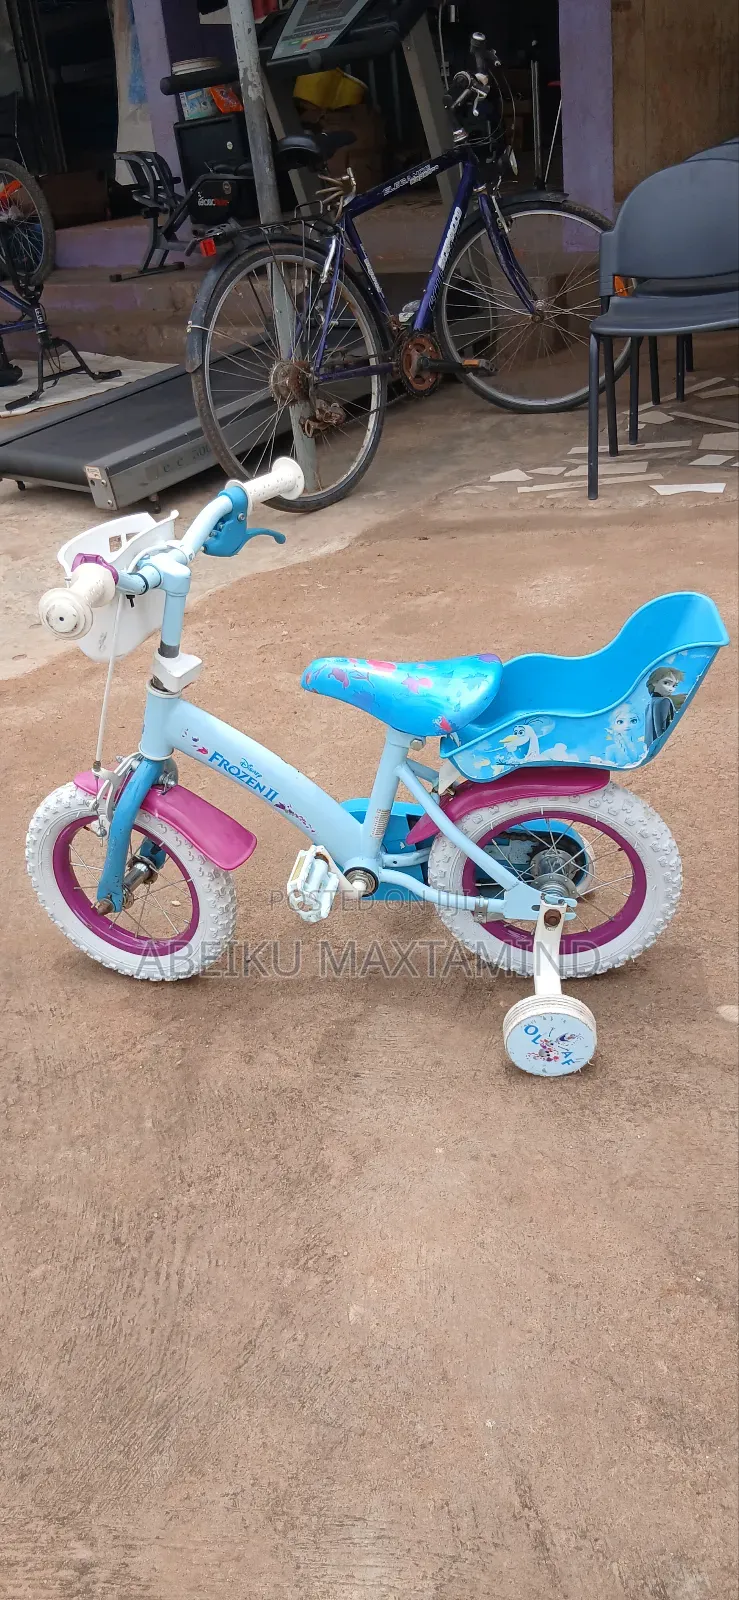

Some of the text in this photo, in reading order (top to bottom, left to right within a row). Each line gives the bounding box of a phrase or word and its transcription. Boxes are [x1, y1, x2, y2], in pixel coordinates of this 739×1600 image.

[208, 751, 279, 802] FROZEN II
[240, 757, 263, 778] Disney
